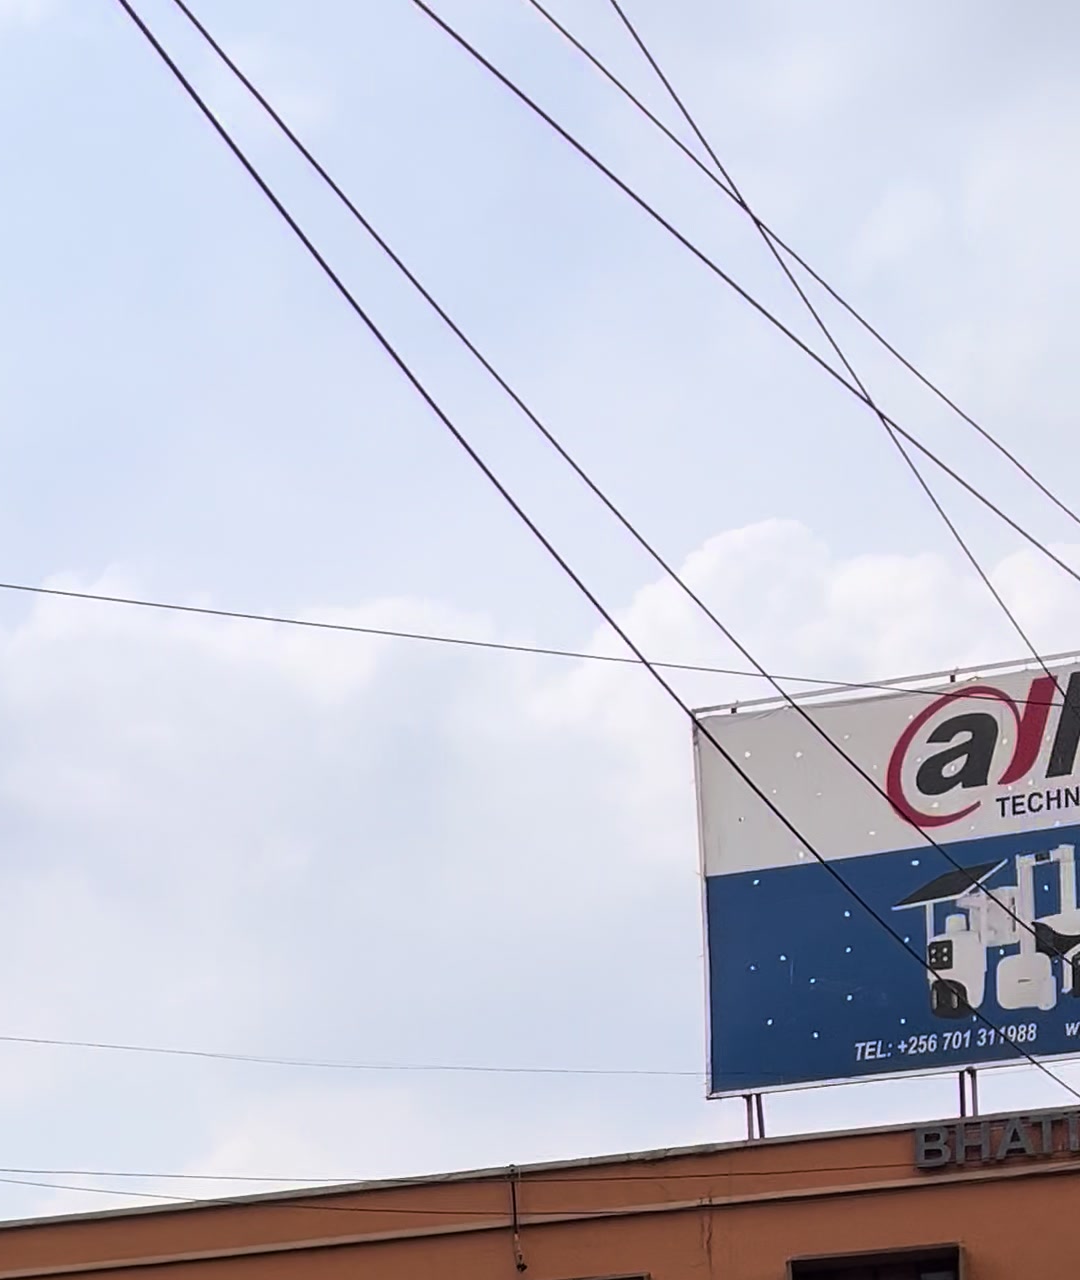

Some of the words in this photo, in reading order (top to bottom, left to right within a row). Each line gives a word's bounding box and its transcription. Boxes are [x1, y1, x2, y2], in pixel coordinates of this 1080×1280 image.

[854, 1041, 893, 1061] TEL:
[897, 1033, 937, 1055] +256
[942, 1029, 971, 1050] 701
[977, 1023, 1037, 1046] 311988
